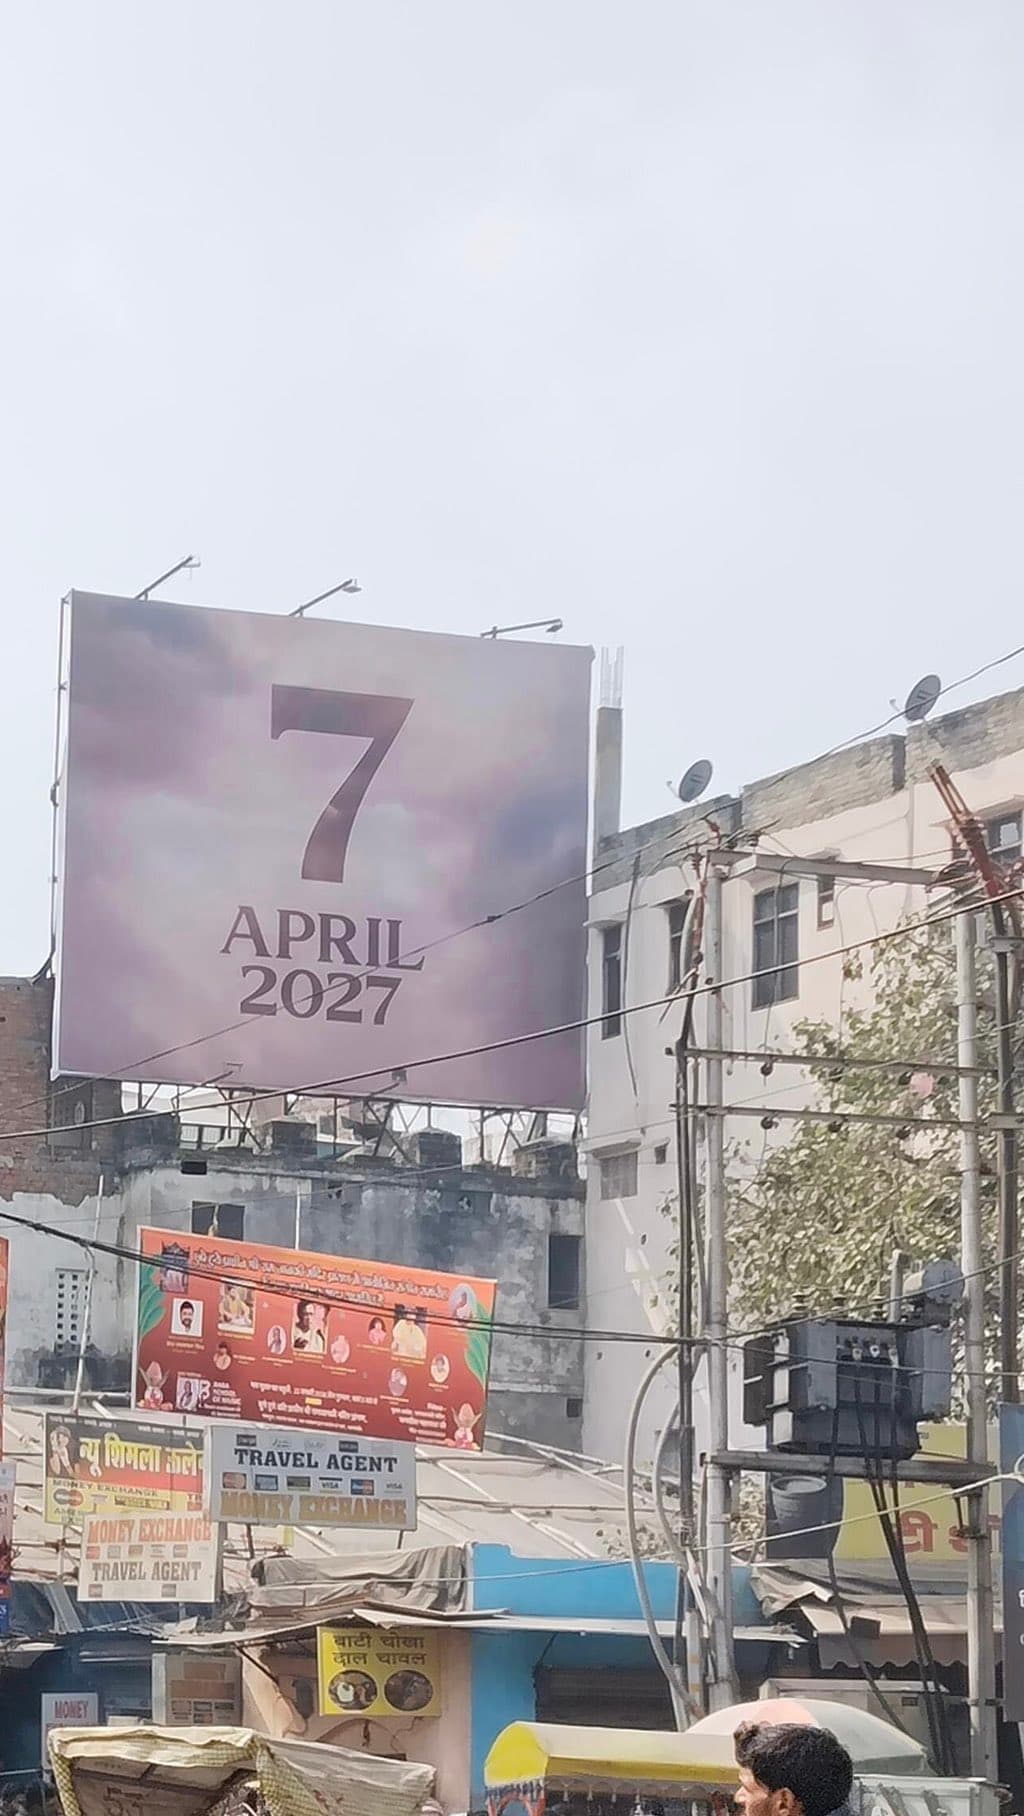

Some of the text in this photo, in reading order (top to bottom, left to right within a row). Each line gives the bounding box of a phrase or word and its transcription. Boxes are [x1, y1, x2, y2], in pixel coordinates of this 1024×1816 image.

[271, 683, 416, 883] 7
[219, 905, 426, 971] APRIL
[239, 964, 403, 1026] 2027
[234, 1447, 398, 1473] TRAVEL AGENT
[220, 1490, 408, 1525] MONEY EXCHANGE
[88, 1517, 212, 1543] MONEY EXCHANGE
[92, 1561, 202, 1581] TRAVEL AGENT
[332, 1651, 428, 1667] दाल चावल
[54, 1700, 89, 1719] MONEY
